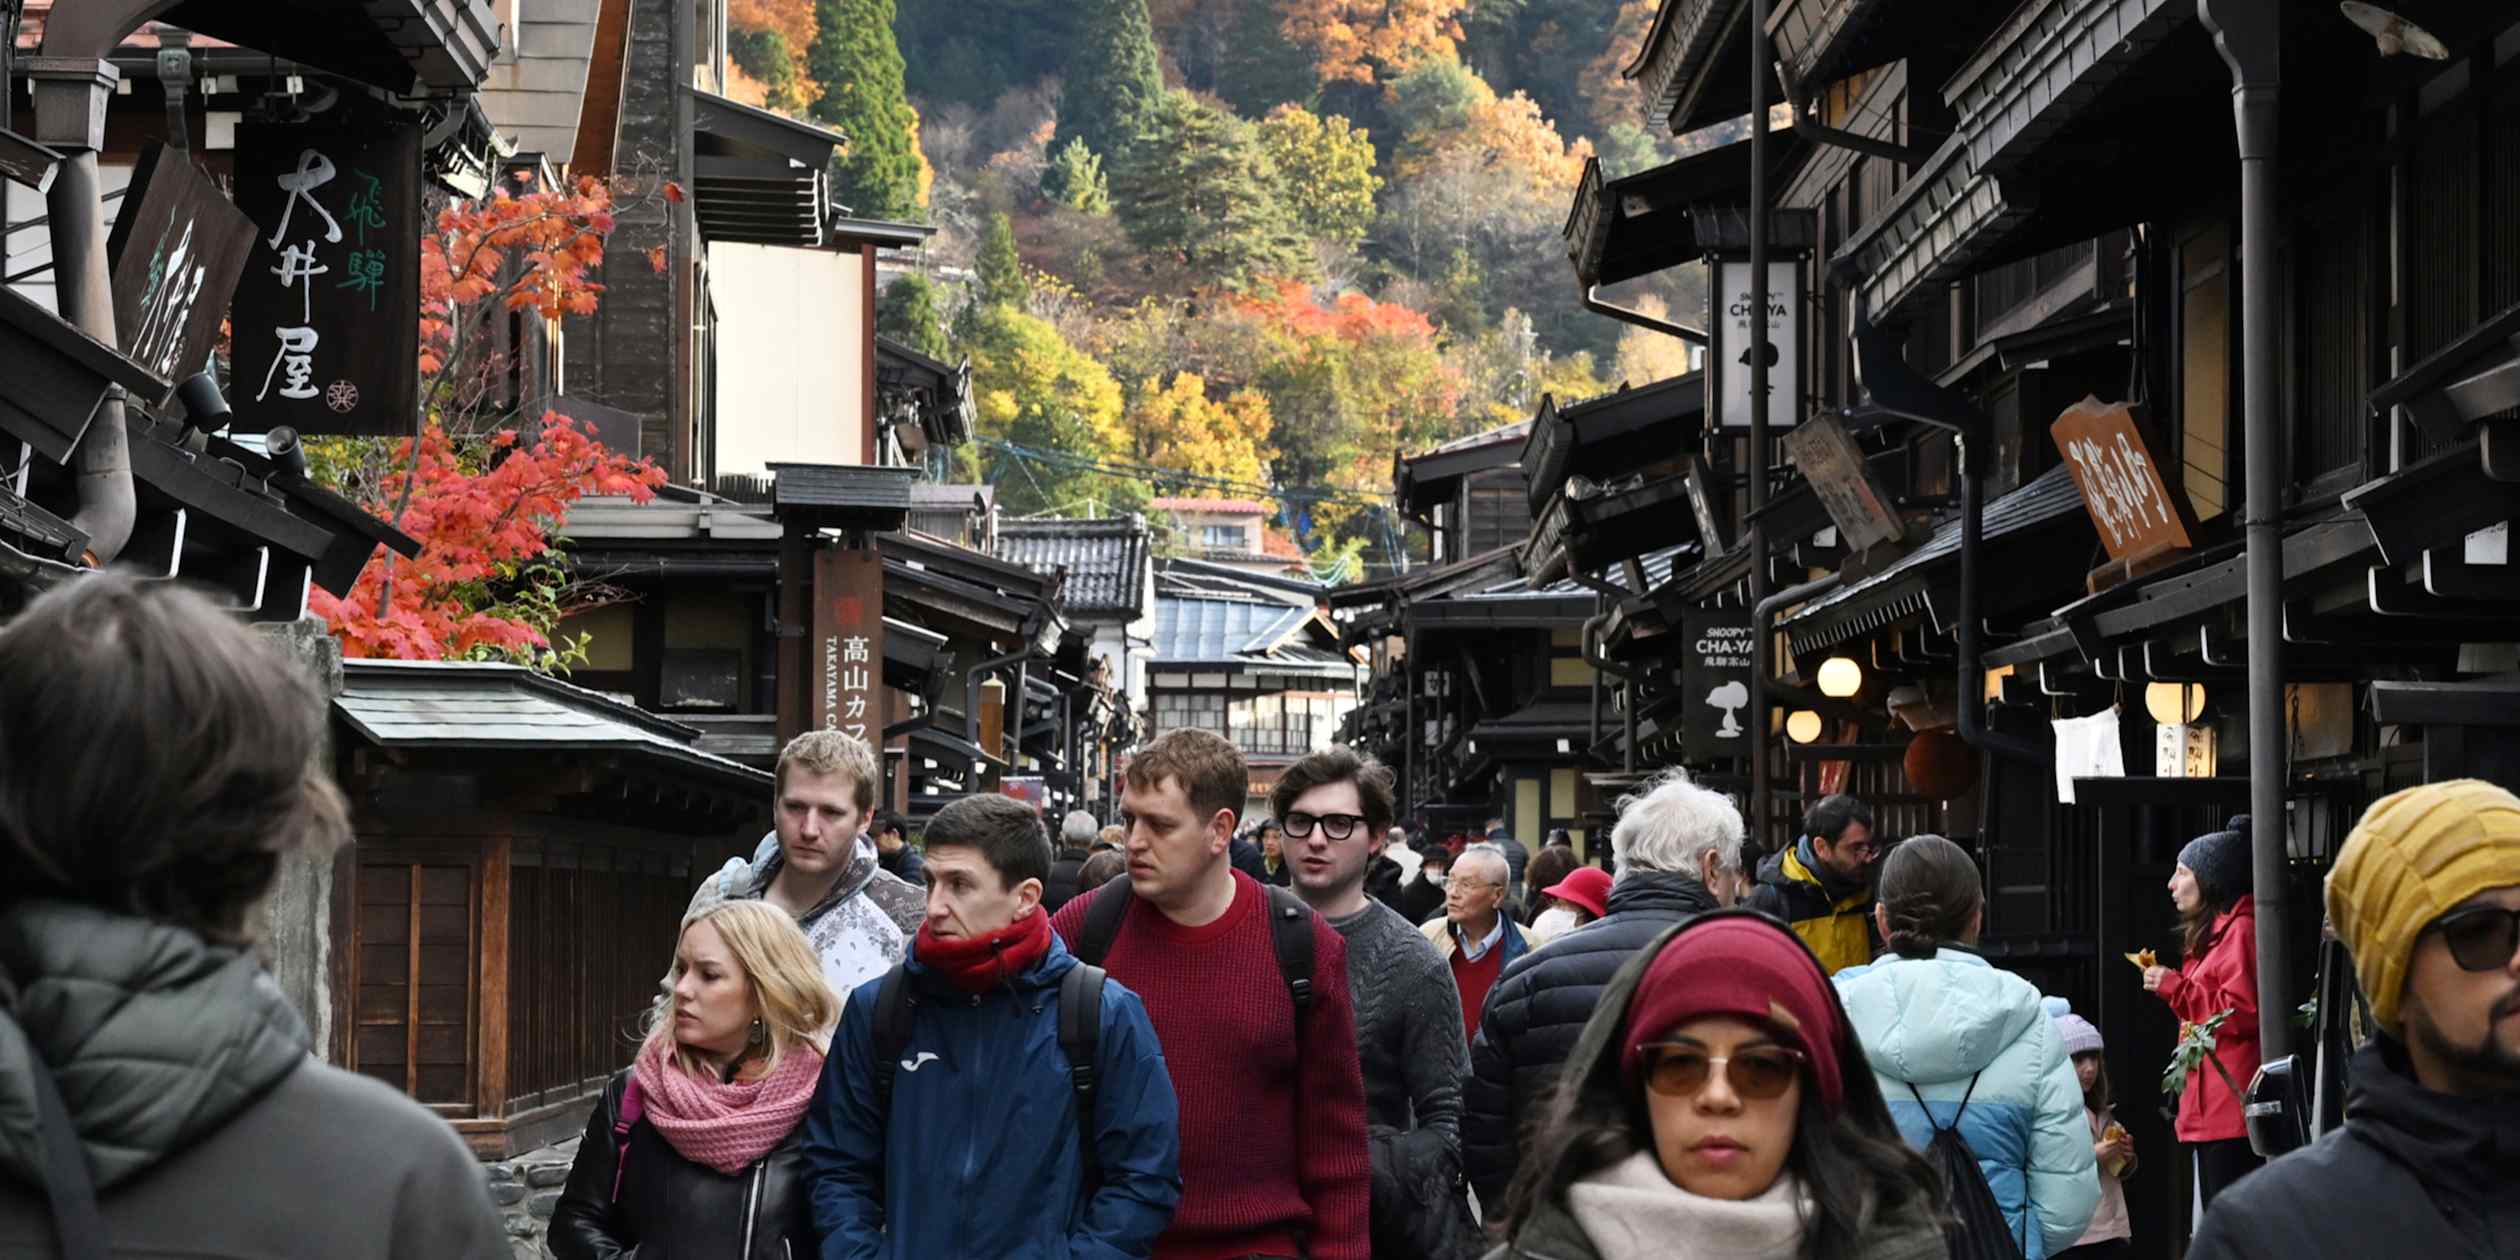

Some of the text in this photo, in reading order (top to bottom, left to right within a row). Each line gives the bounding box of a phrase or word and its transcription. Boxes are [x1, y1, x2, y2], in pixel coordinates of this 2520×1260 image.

[256, 149, 343, 401] 大井屋
[1730, 303, 1787, 316] CHYA
[826, 635, 838, 732] TAKAYAMA CA
[843, 635, 869, 741] 高山カフ
[1696, 640, 1754, 653] CHA-YA
